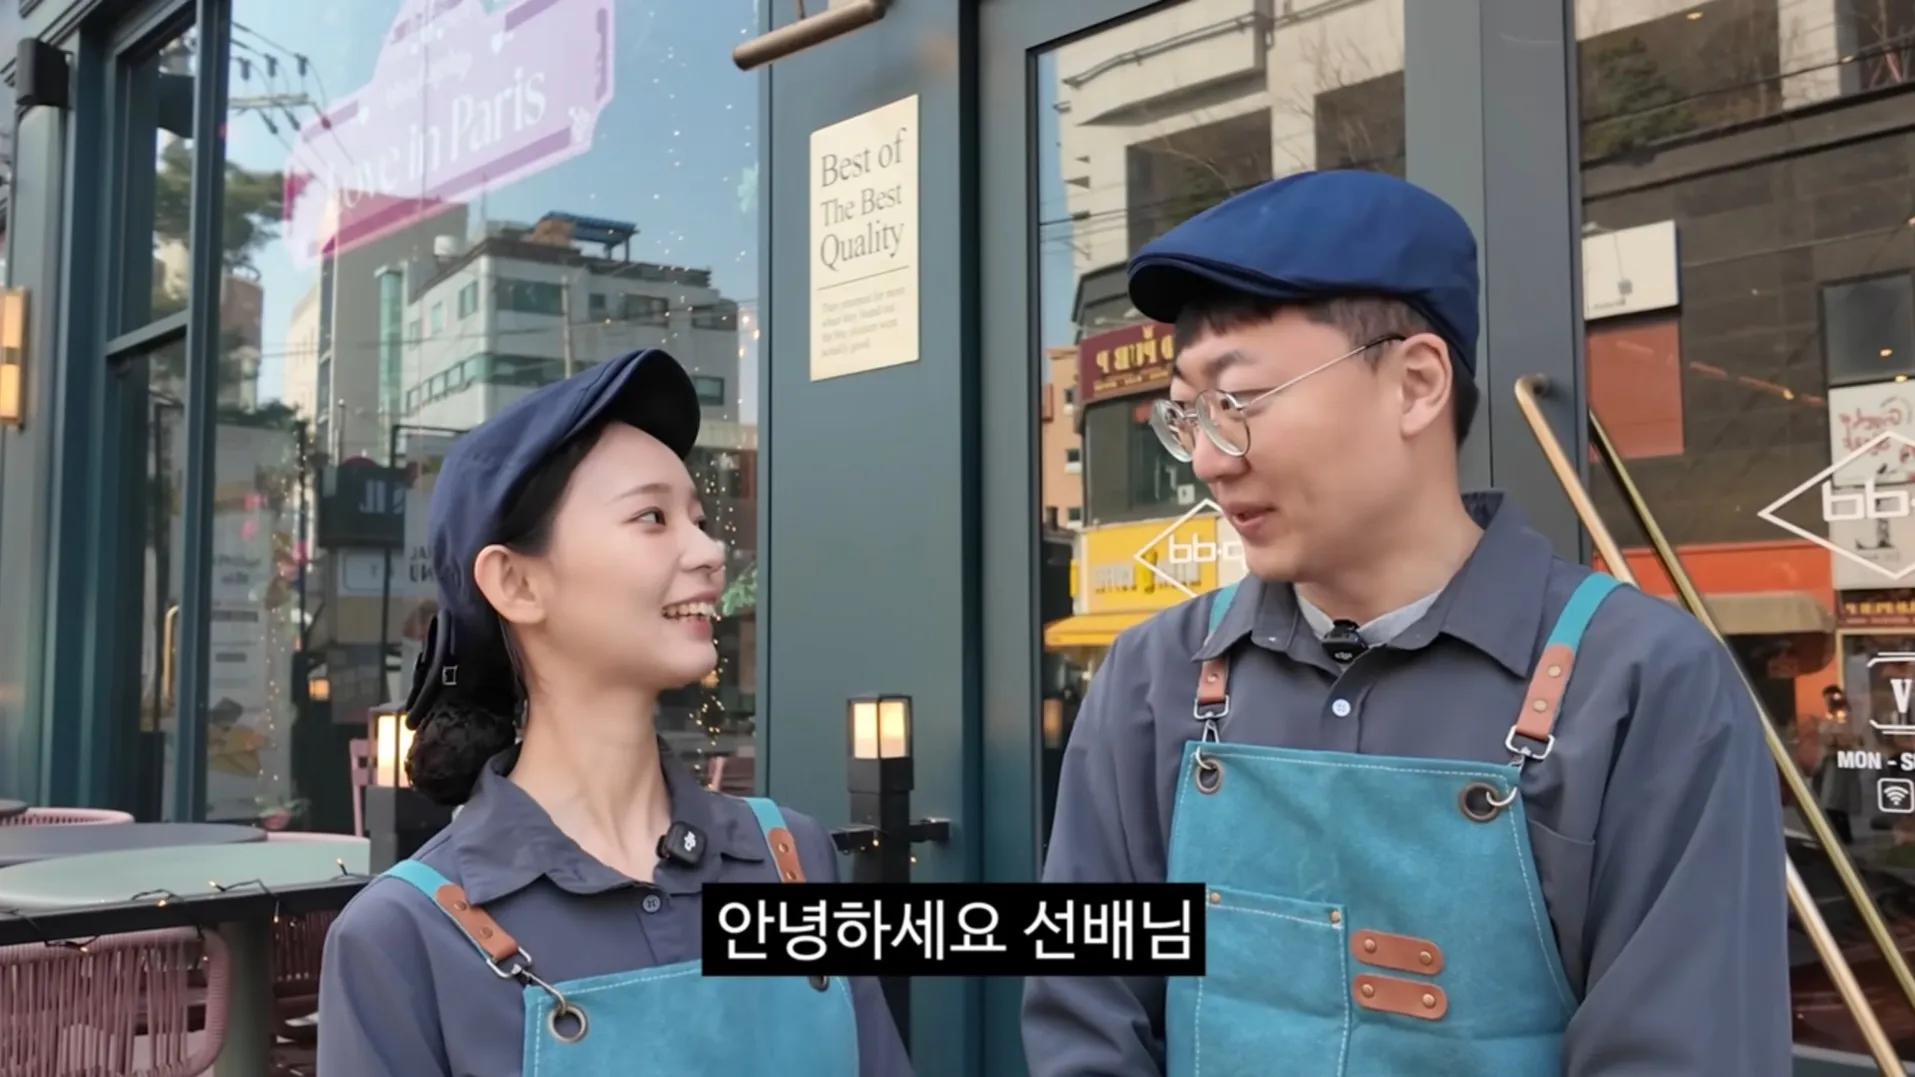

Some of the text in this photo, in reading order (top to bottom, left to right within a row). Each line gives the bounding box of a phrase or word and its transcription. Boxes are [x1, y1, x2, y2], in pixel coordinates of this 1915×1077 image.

[408, 123, 441, 179] in
[449, 66, 547, 162] Paris
[821, 127, 907, 188] Best of
[820, 185, 902, 227] The Best
[820, 219, 905, 272] Quality
[1838, 751, 1882, 769] MON
